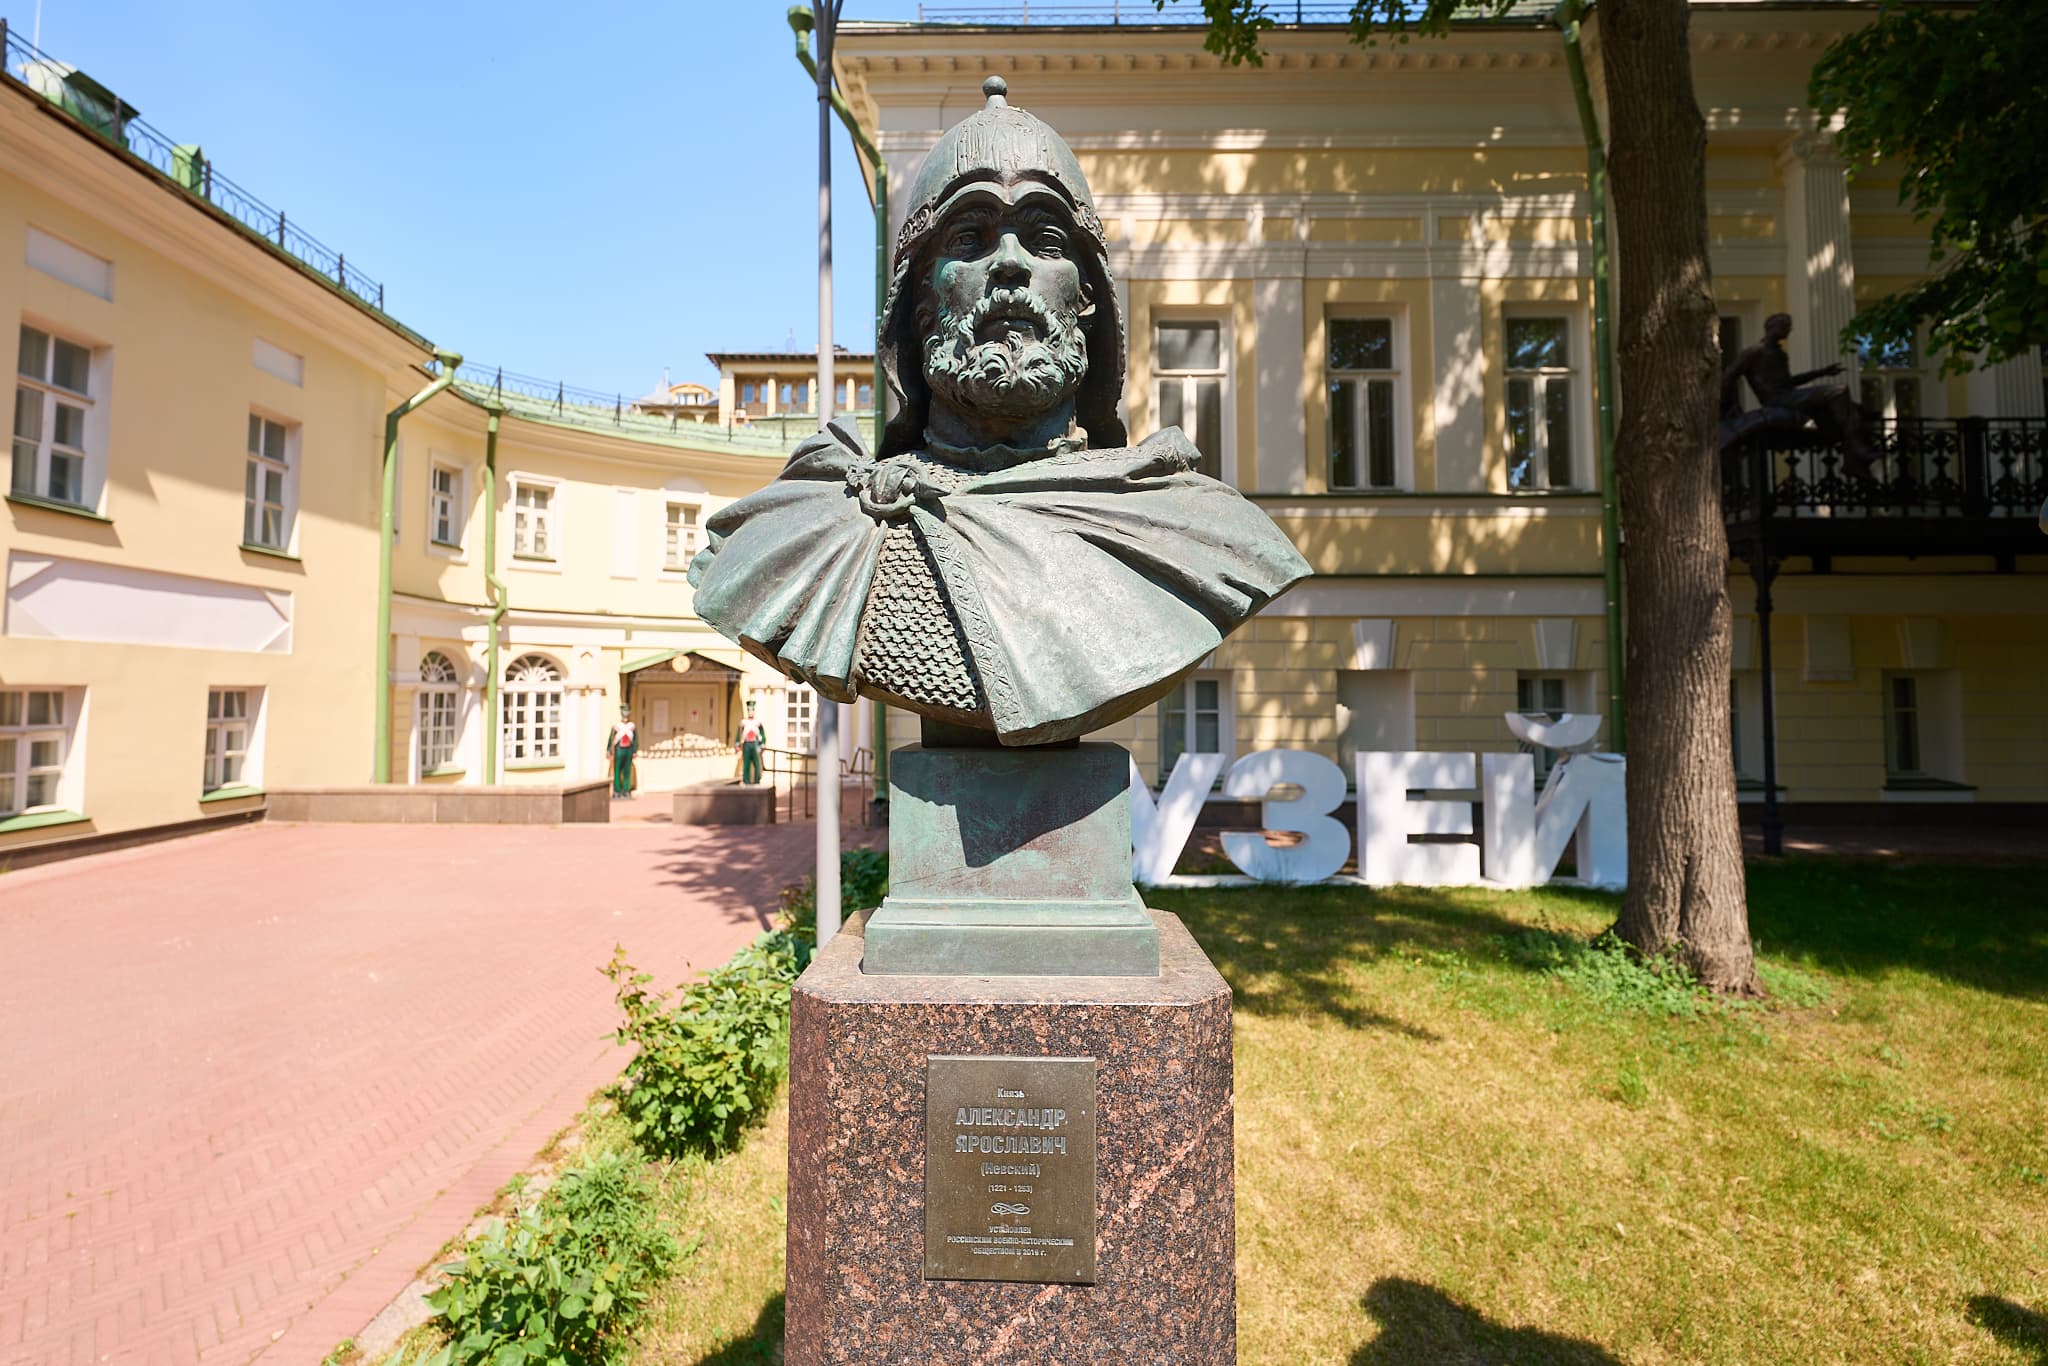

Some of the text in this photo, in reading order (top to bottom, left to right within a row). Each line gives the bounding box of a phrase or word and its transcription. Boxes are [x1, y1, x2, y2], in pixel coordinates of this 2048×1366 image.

[1130, 712, 1627, 886] УЗЕЙ
[955, 1107, 1066, 1130] АЛЕКСАНДР
[955, 1135, 1067, 1155] ЯРОСЛАВИЧ
